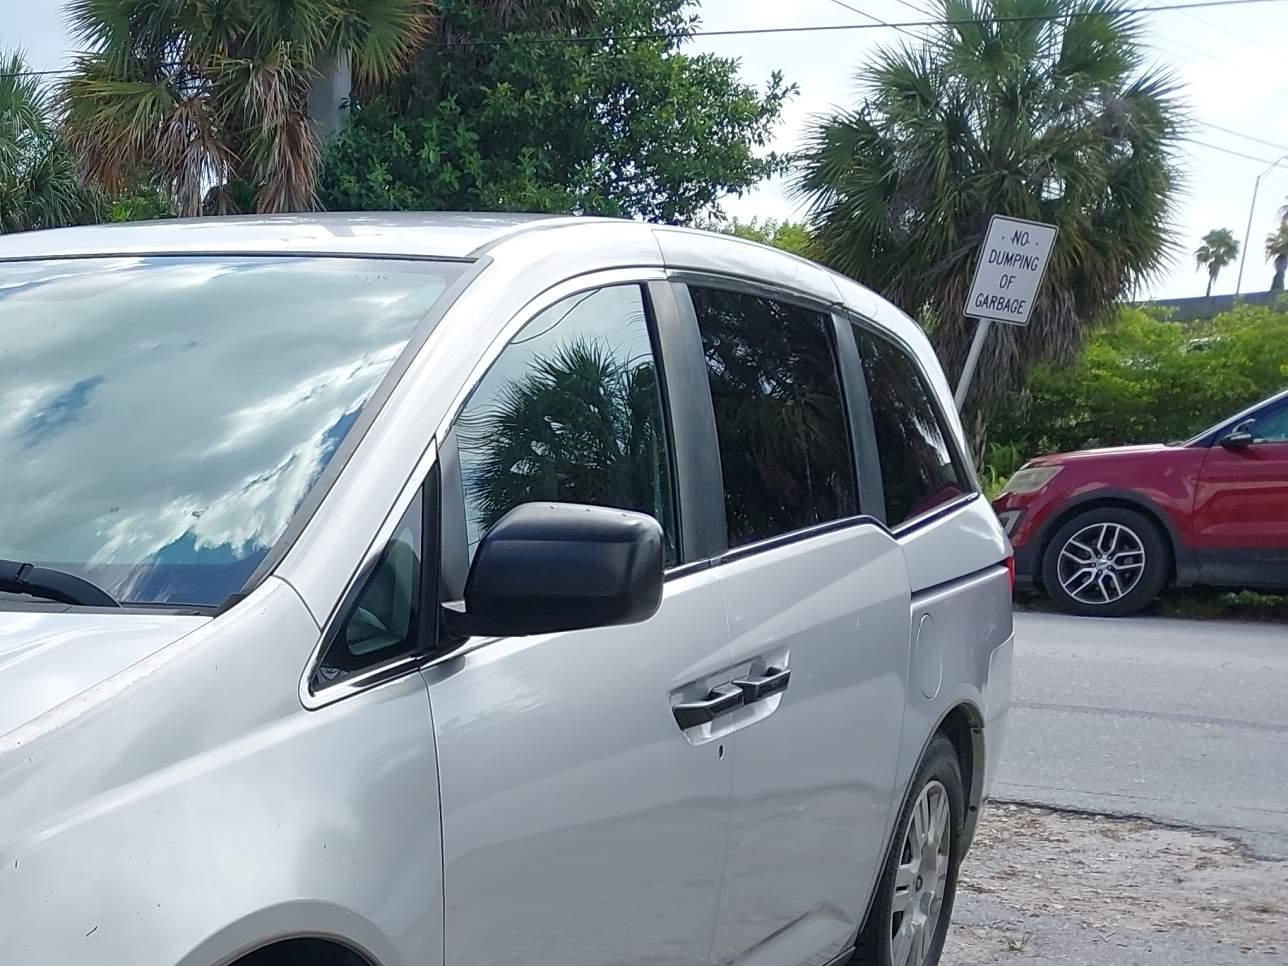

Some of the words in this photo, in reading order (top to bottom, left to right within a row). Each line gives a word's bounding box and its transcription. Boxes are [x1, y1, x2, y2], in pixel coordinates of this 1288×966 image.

[1011, 230, 1030, 247] NO
[988, 249, 1040, 272] DUMPING
[999, 274, 1016, 290] OF
[975, 292, 1026, 315] GARBAGE
